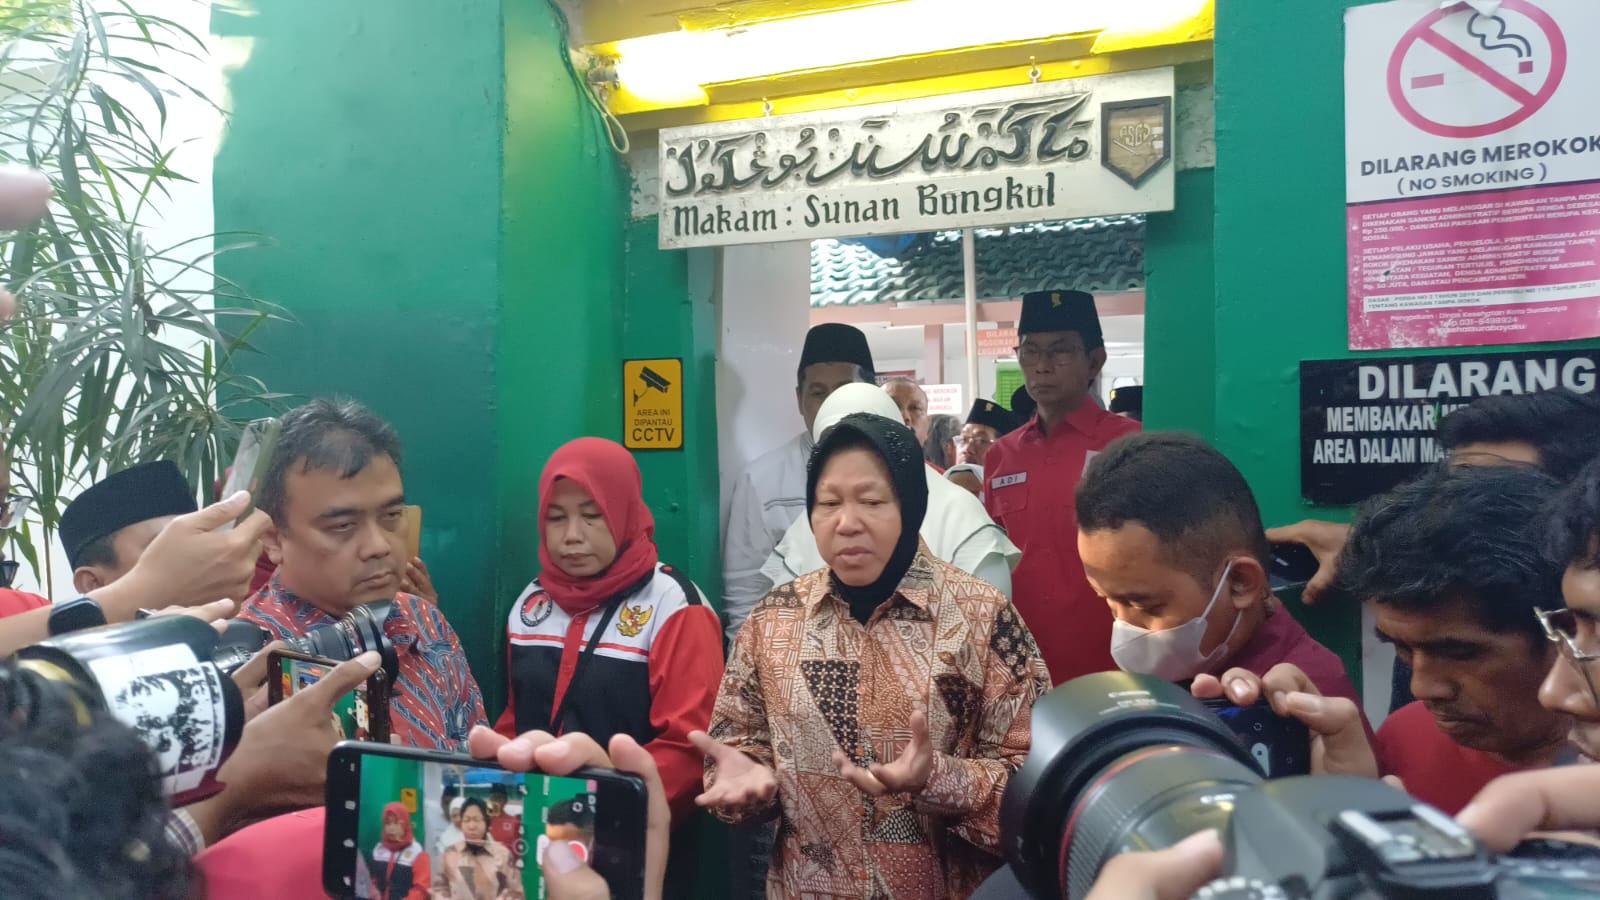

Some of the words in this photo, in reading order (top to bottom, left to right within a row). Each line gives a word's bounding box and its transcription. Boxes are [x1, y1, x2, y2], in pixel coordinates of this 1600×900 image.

[1360, 149, 1476, 176] DILARANG
[1482, 135, 1600, 163] MEROKOK
[804, 194, 900, 228] Sunan
[916, 171, 1055, 216] Bungkul
[1358, 358, 1596, 400] DILARANG
[632, 428, 674, 442] CCTV
[1326, 404, 1436, 432] MEMBAKAR
[1313, 439, 1356, 464] AREA
[1360, 438, 1415, 463] DALAM
